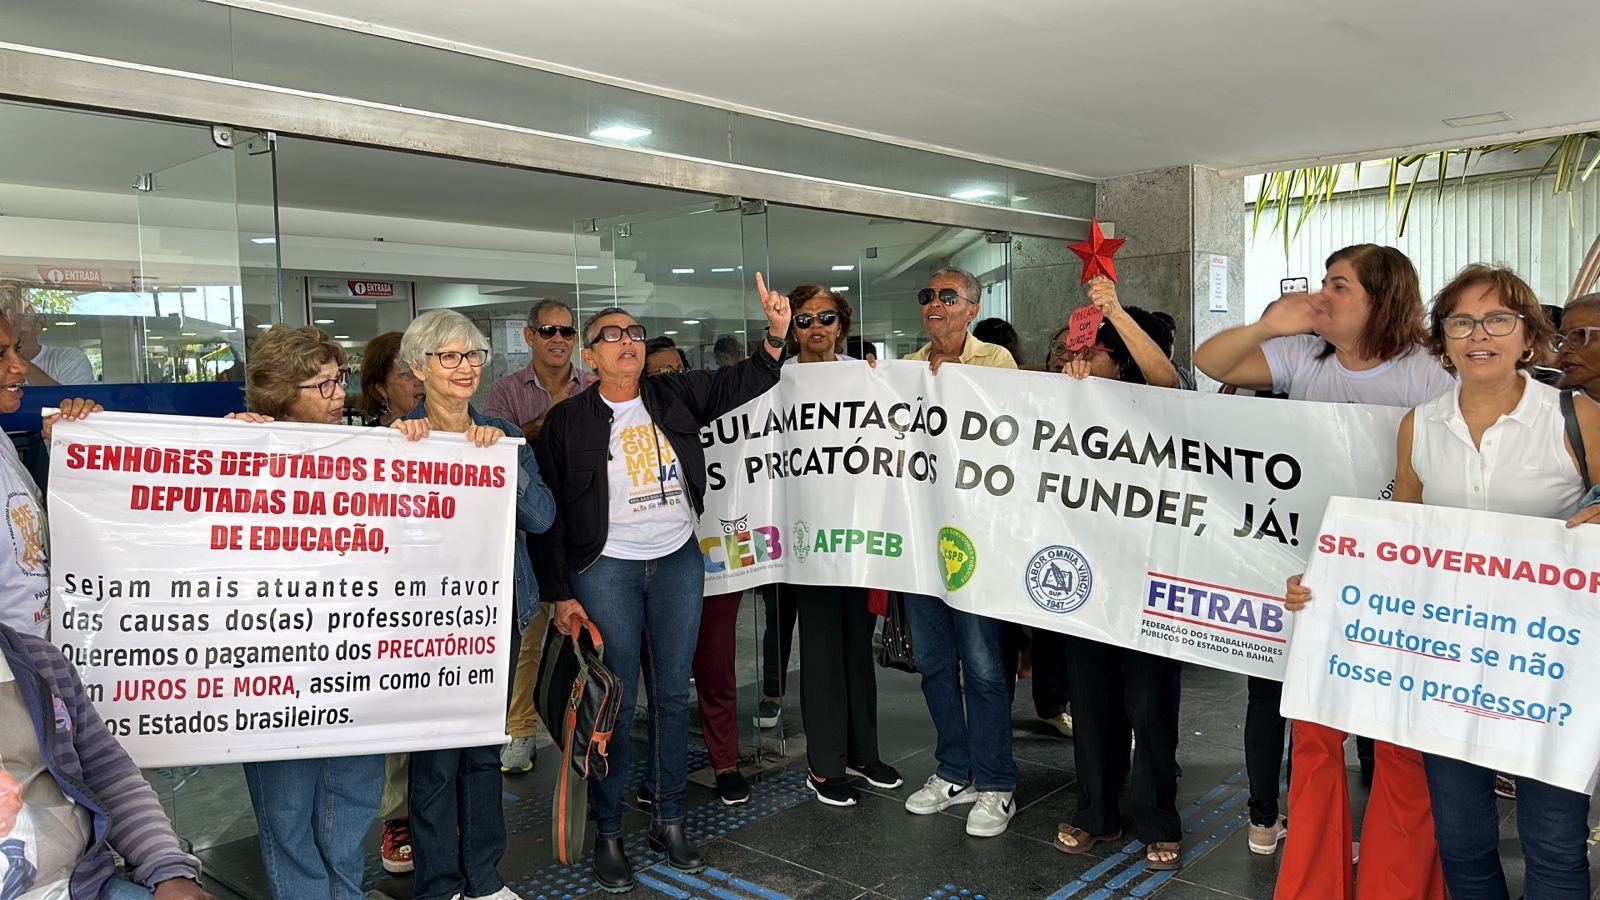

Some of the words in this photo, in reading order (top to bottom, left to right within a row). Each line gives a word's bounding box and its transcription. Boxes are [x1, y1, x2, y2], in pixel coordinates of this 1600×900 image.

[65, 270, 99, 280] ENTRADA
[367, 283, 391, 292] ENTRADA
[1079, 321, 1091, 331] COM
[700, 396, 948, 448] GULAMENTAÇÃO
[960, 411, 1019, 446] DO
[1032, 419, 1301, 490] PAGAMENTO
[66, 444, 214, 476] SENHORES
[219, 447, 368, 482] DEPUTADOS
[373, 458, 385, 481] E
[391, 459, 506, 488] SENHORAS
[130, 484, 286, 516] DEPUTADAS
[293, 491, 327, 516] DA
[333, 491, 456, 519] COMISSÃO
[744, 437, 938, 485] PRECATÓRIOS
[955, 459, 1015, 496] DO
[1036, 472, 1208, 536] FUNDEF,
[1233, 498, 1299, 547] JÁ!
[210, 525, 243, 551] DE
[250, 522, 390, 556] EDUCAÇÃO,
[813, 528, 903, 558] AFPEB
[1317, 534, 1365, 558] SR.
[64, 573, 151, 602] Sejam
[170, 575, 239, 599] mais
[256, 577, 379, 598] atuantes
[394, 580, 426, 597] em
[440, 576, 500, 596] favor
[1030, 555, 1047, 589] LABOR
[1048, 550, 1078, 565] OMNIA
[1076, 564, 1088, 599] VINCIT
[62, 607, 103, 632] das
[119, 611, 210, 632] causas
[225, 606, 314, 634] dos(as)
[328, 605, 498, 636] professores(as)!
[1046, 599, 1064, 609] 1947
[1147, 580, 1284, 633] FETRAB
[1341, 585, 1361, 605] O
[1368, 591, 1416, 616] que
[1422, 604, 1517, 634] seriam
[1527, 616, 1582, 646] dos
[185, 648, 198, 665] o
[205, 642, 329, 669] pagamento
[336, 639, 372, 661] dos
[377, 632, 496, 659] PRECATÓRIOS
[1141, 628, 1180, 643] PÚBLICOS
[1181, 637, 1195, 646] DO
[1197, 641, 1230, 654] ESTADO
[1231, 649, 1244, 658] DA
[1246, 652, 1274, 664] BAHIA
[1142, 619, 1188, 635] FEDERAÇÃO
[1190, 630, 1208, 640] DOS
[1210, 634, 1283, 656] TRABALHADORES
[1344, 619, 1461, 660] doutores
[1470, 646, 1499, 667] se
[1508, 652, 1565, 680] não
[112, 678, 187, 702] JUROS
[197, 676, 225, 698] DE
[234, 673, 301, 700] MORA,
[309, 673, 371, 694] assim
[379, 671, 431, 691] como
[437, 666, 461, 687] foi
[467, 667, 494, 684] em
[1328, 654, 1392, 687] fosse
[1399, 675, 1414, 692] o
[1422, 677, 1573, 727] professor?
[138, 710, 229, 736] Estados
[235, 705, 354, 731] brasileiros.
